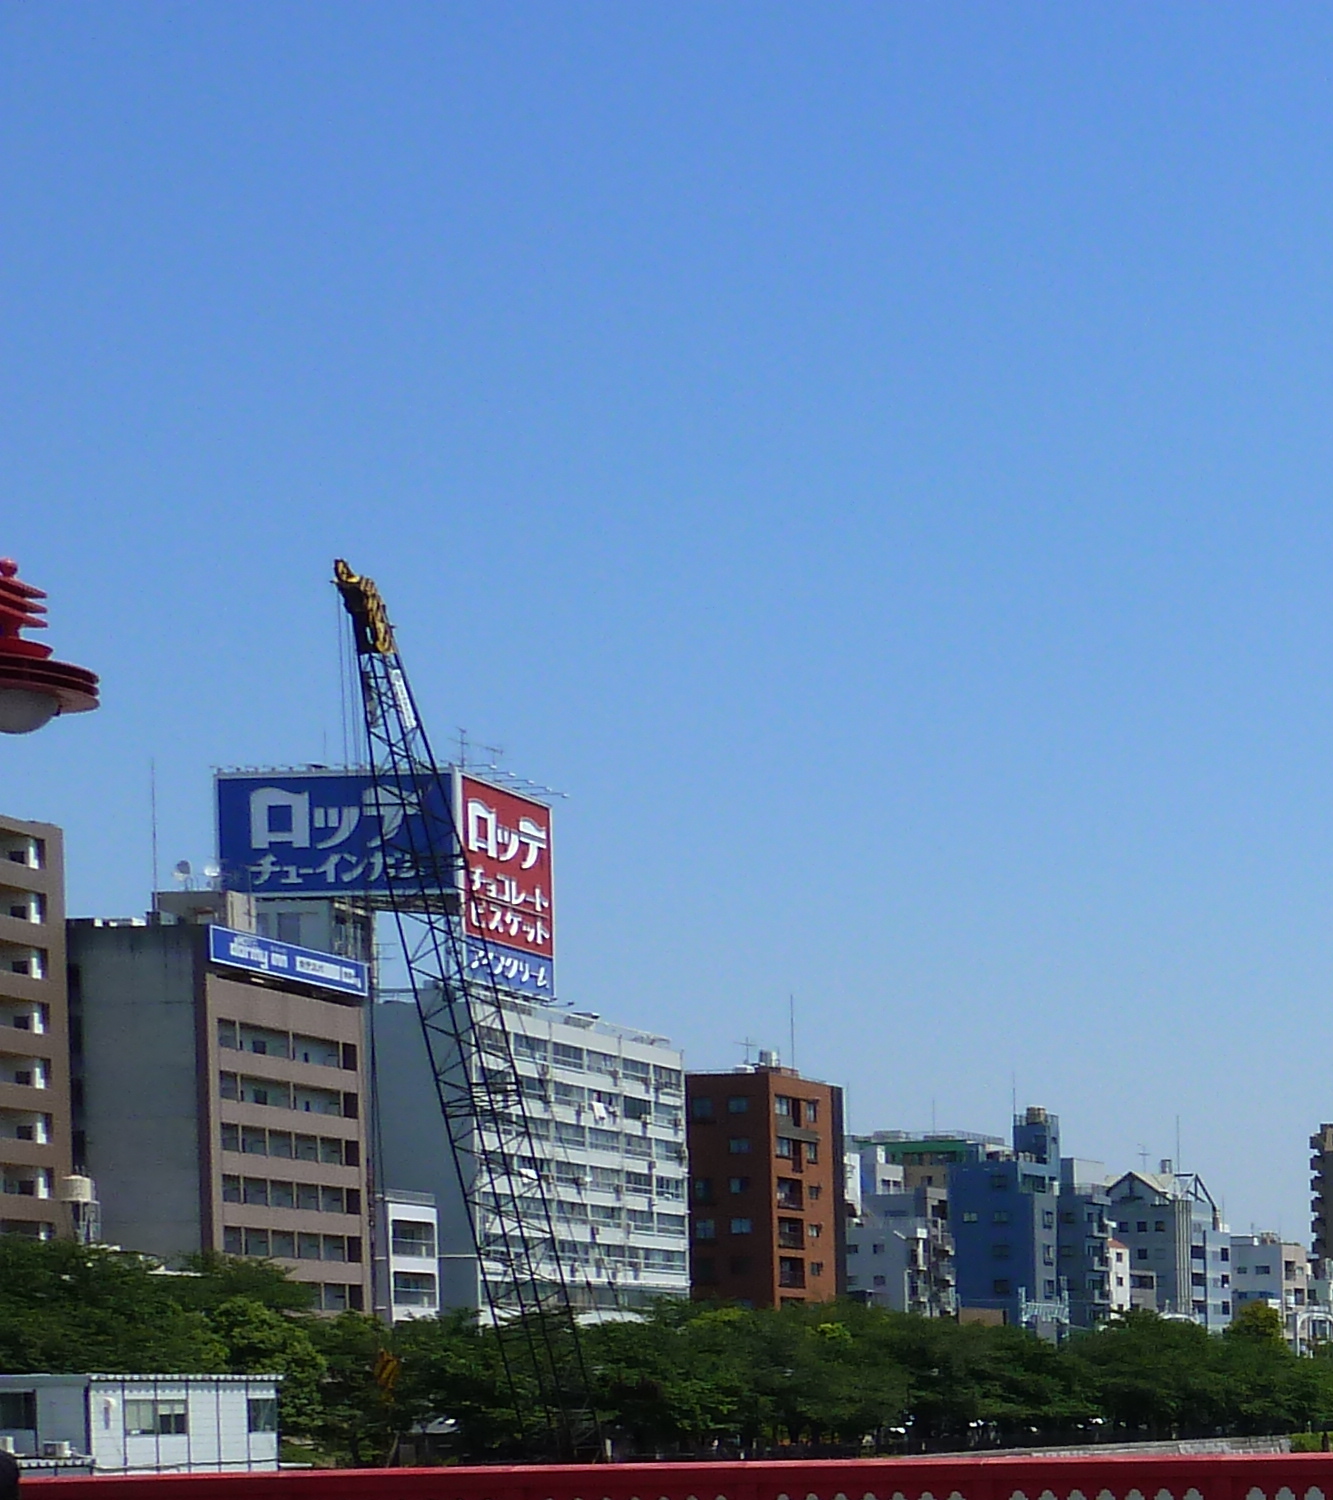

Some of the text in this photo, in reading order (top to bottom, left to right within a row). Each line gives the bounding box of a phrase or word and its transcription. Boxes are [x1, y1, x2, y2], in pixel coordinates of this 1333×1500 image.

[250, 786, 423, 849] ロッテ
[468, 798, 547, 870] ロッテ
[470, 866, 549, 913] チョコレート
[470, 901, 550, 945] ビスケット
